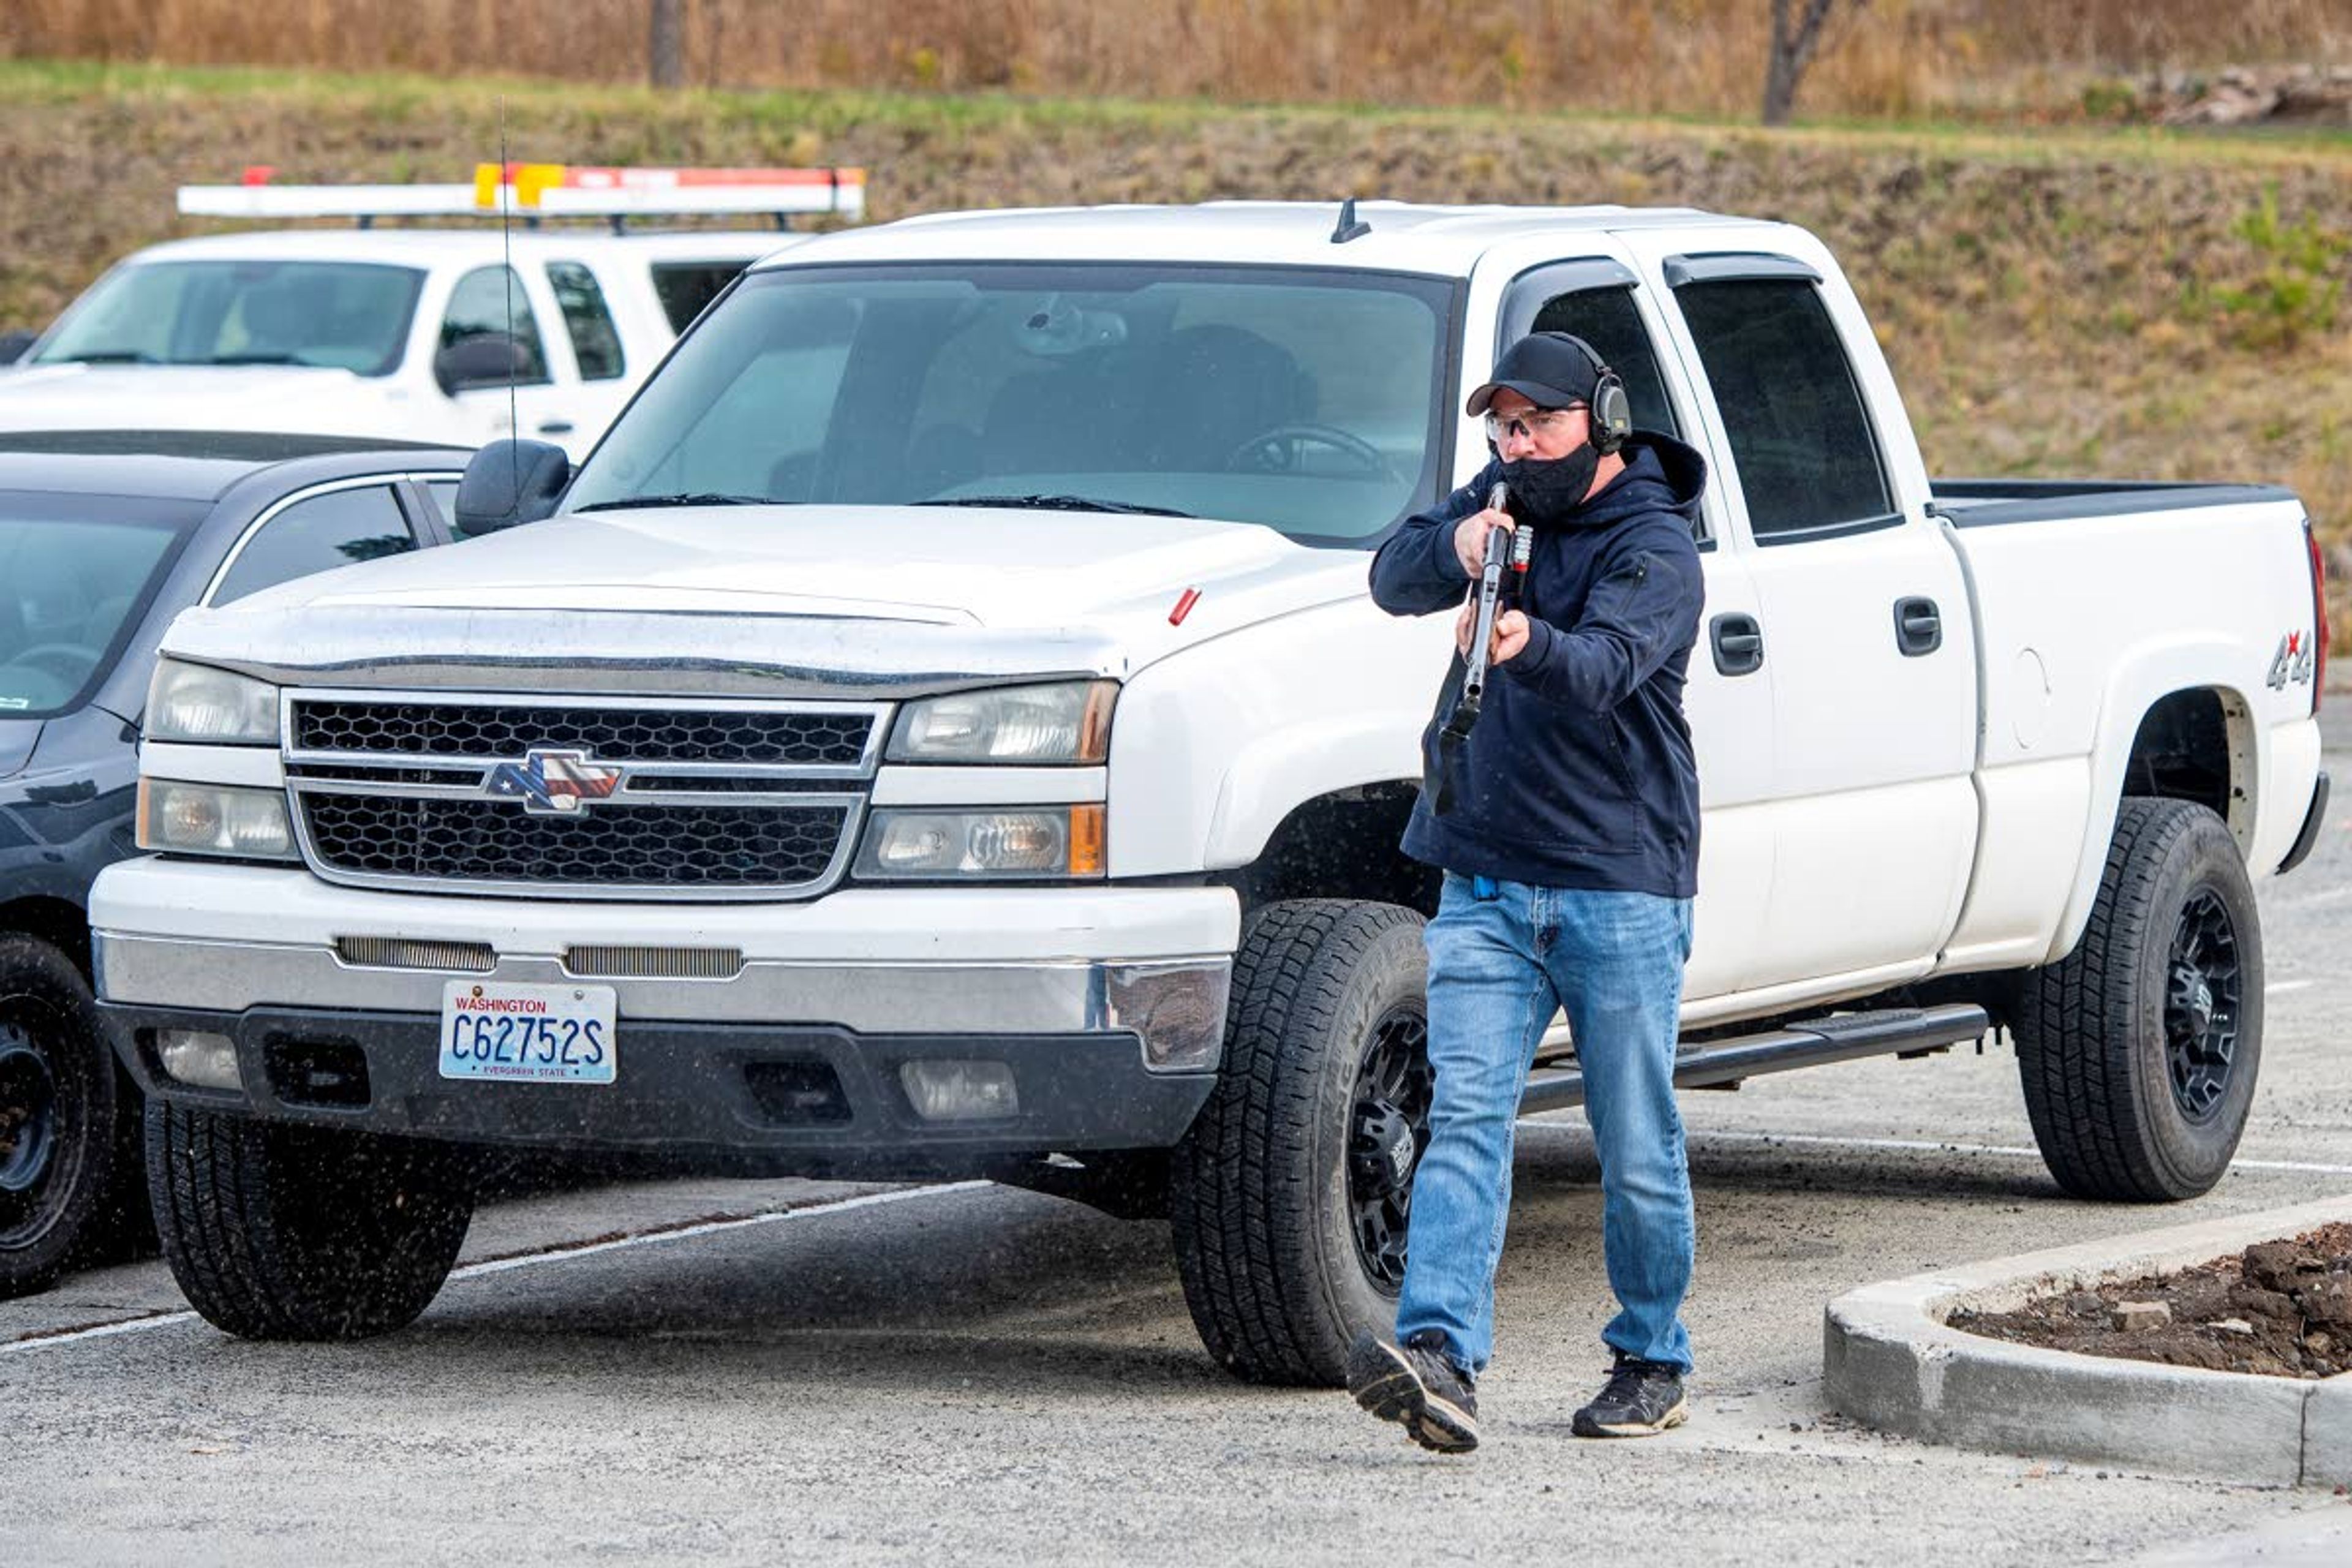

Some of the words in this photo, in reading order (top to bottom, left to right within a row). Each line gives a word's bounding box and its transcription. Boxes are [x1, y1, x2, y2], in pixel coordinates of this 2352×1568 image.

[456, 997, 546, 1013] WASHINGTON
[453, 1014, 603, 1065] C62752S
[484, 1066, 534, 1075] EVERGREEN
[539, 1068, 566, 1077] STATE
